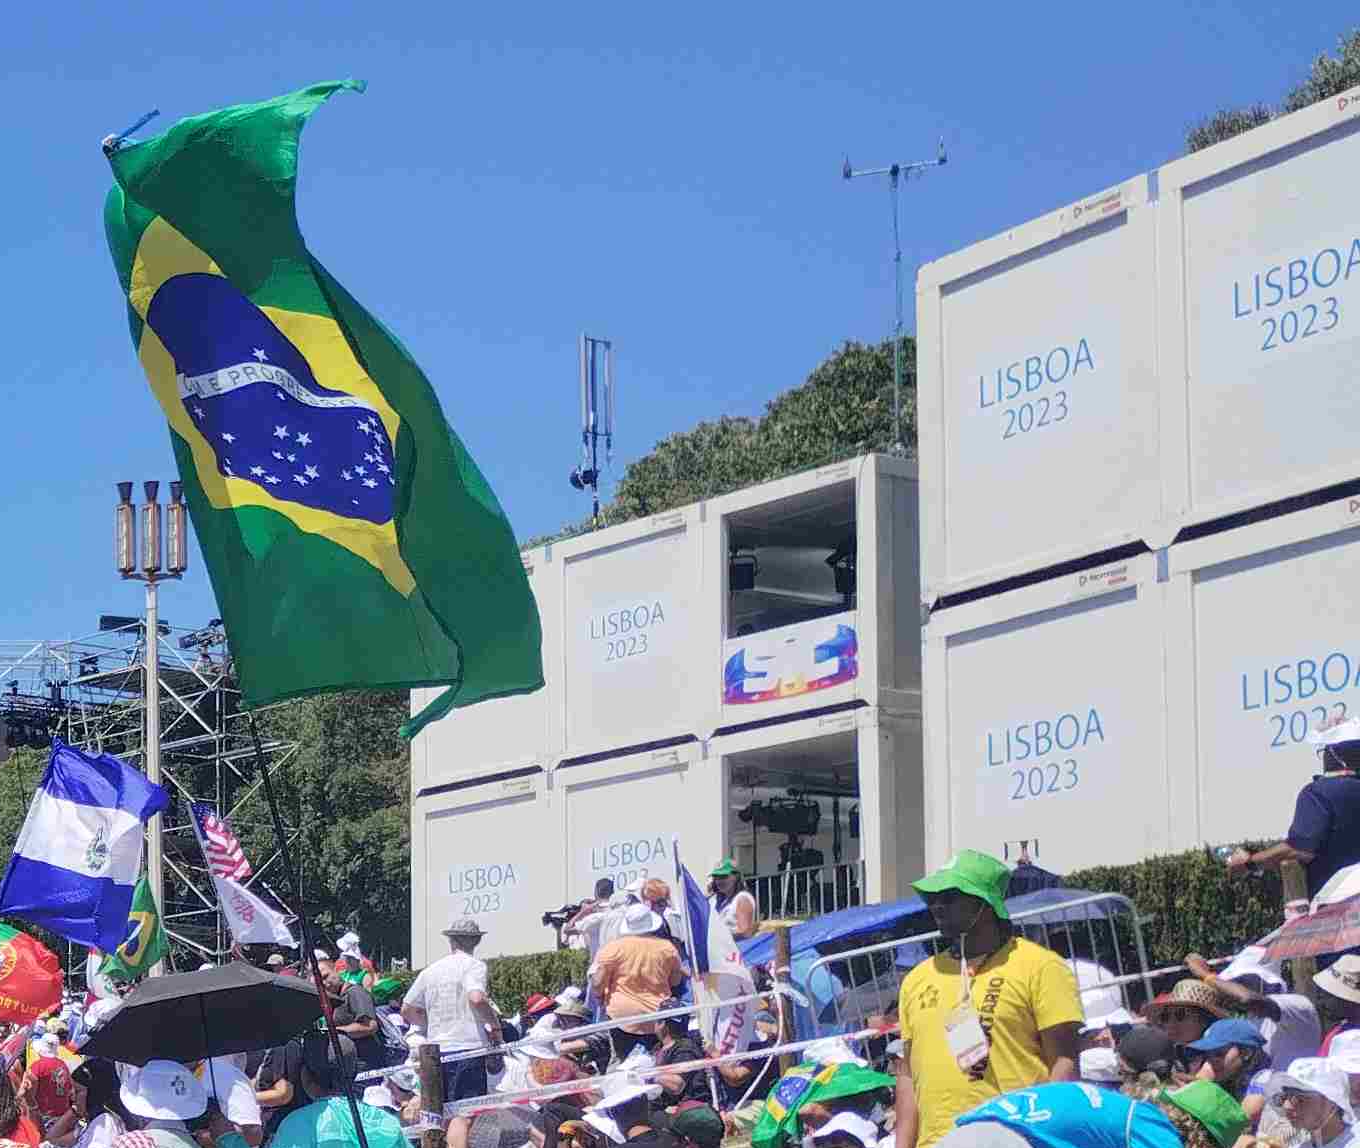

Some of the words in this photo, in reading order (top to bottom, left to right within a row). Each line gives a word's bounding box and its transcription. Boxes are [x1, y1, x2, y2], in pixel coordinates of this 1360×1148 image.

[1260, 297, 1338, 352] 2023
[979, 338, 1095, 409] LISBOA
[1002, 391, 1069, 440] 2023
[592, 599, 665, 640] LISBOA
[605, 632, 648, 662] 2023
[1241, 652, 1360, 710] LISBO
[985, 708, 1105, 767] LISBOA
[1011, 759, 1079, 800] 2023
[591, 837, 666, 870] LISBOA
[448, 864, 517, 894] LISBOA
[463, 891, 501, 915] 2023
